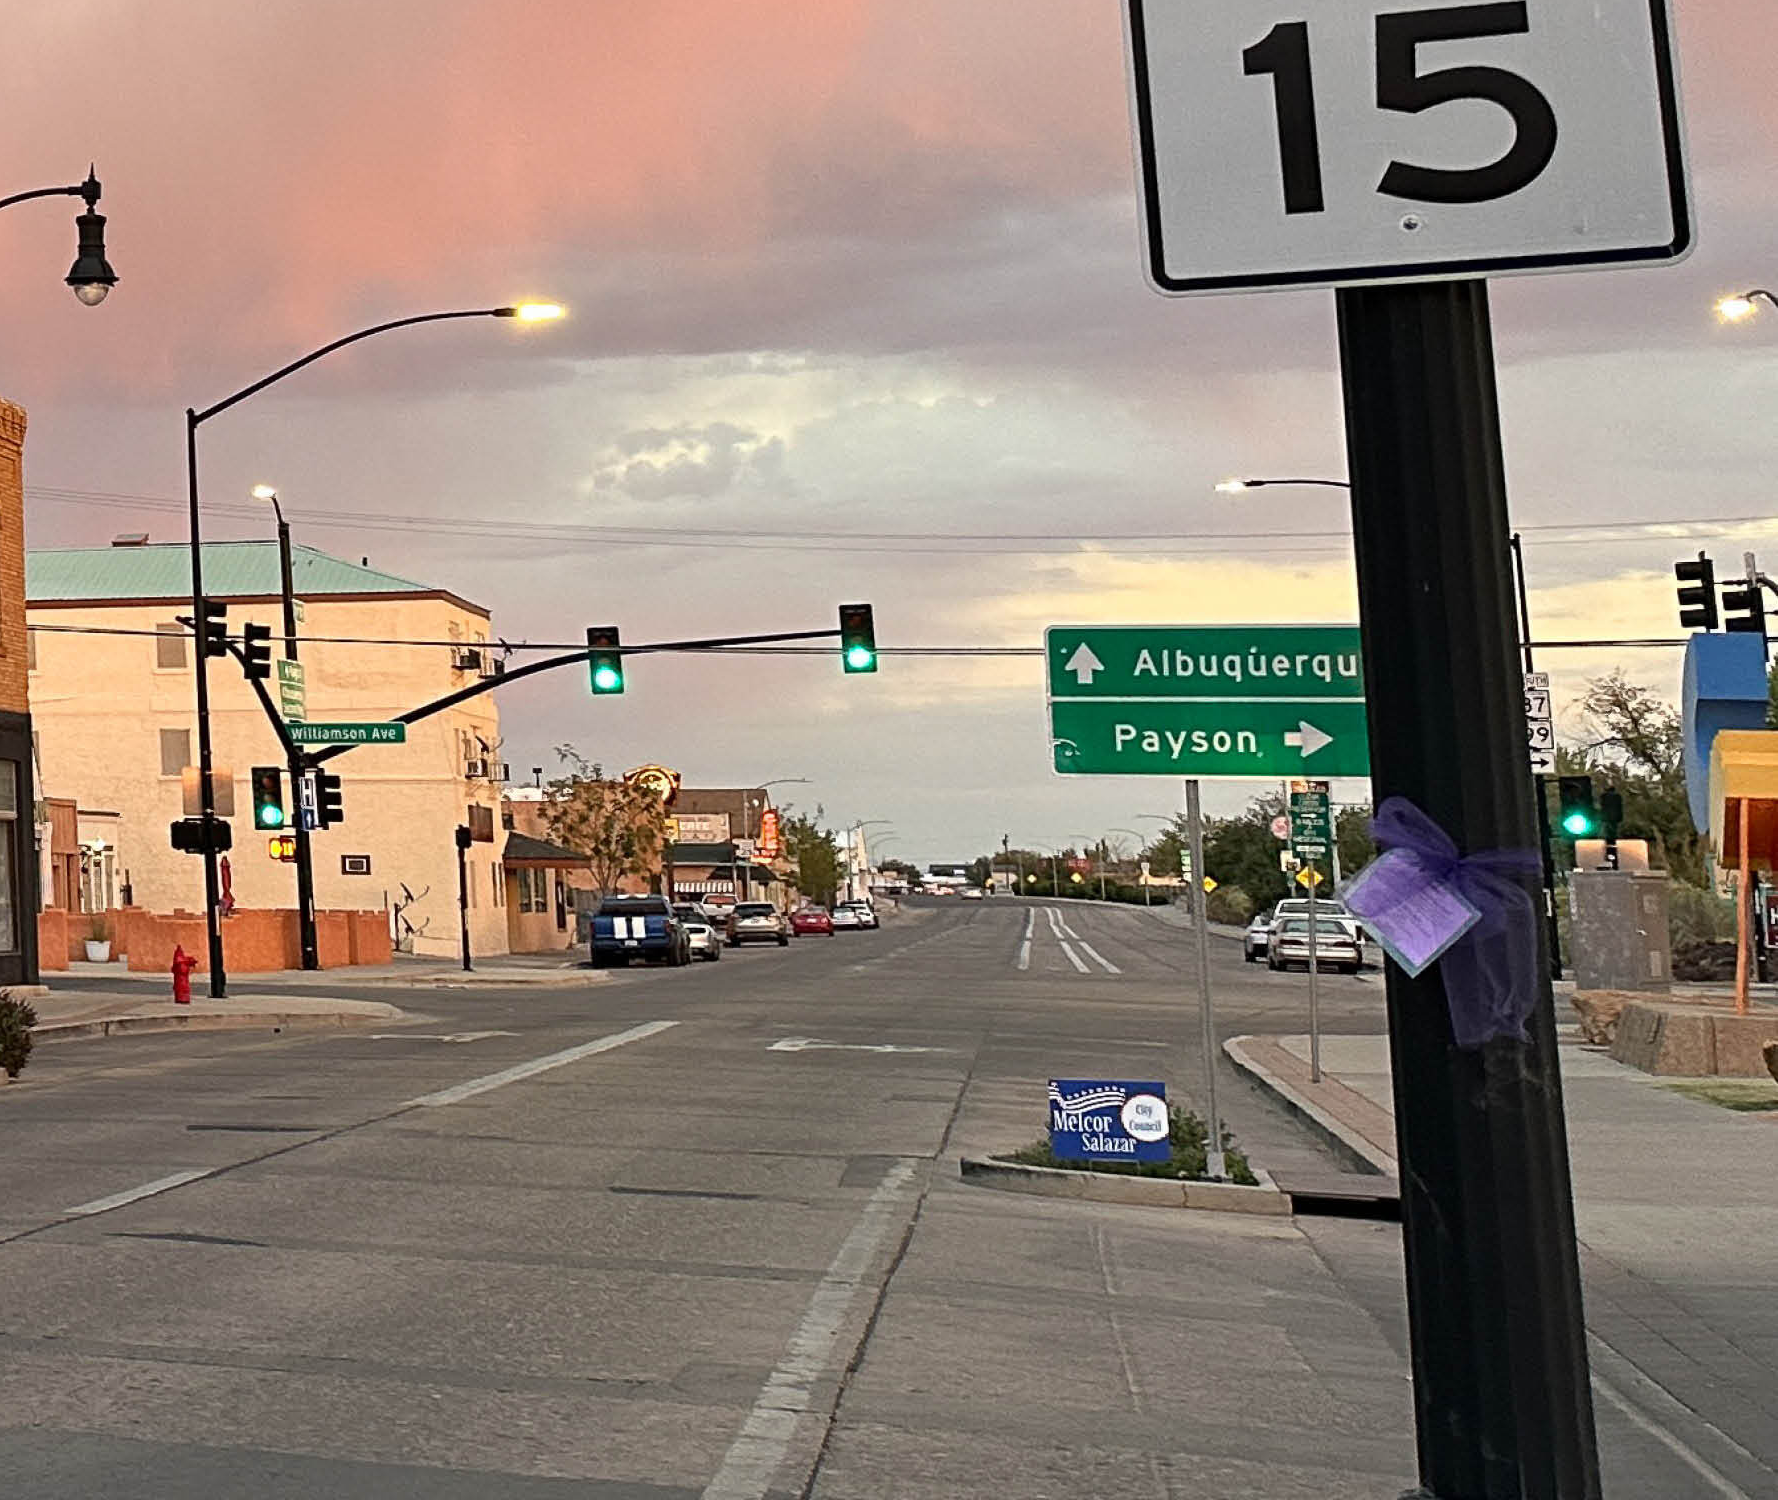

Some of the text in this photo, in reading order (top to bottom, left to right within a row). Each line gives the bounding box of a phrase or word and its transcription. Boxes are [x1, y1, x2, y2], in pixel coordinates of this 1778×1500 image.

[1242, 0, 1558, 215] 15
[1133, 649, 1358, 683] Albuquerqu
[291, 727, 396, 740] Williamson Ave
[1115, 724, 1257, 759] Payson
[1054, 1109, 1113, 1133] Melcor
[1081, 1133, 1138, 1154] Salazar
